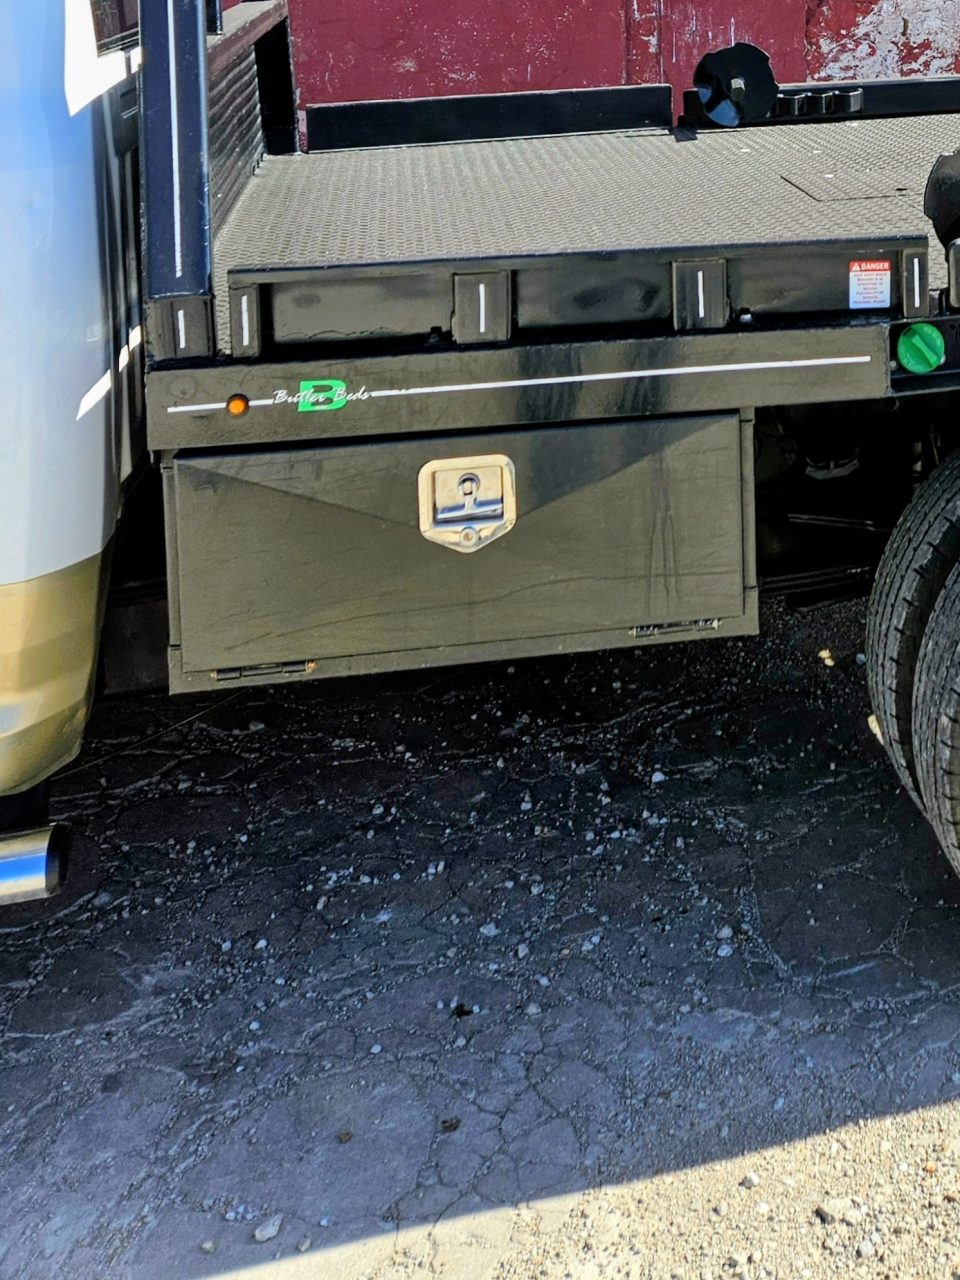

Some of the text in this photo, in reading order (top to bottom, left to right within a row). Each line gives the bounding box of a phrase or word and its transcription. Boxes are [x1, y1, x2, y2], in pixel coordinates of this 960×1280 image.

[861, 261, 889, 271] DANGER
[273, 385, 370, 404] Butler Beds
